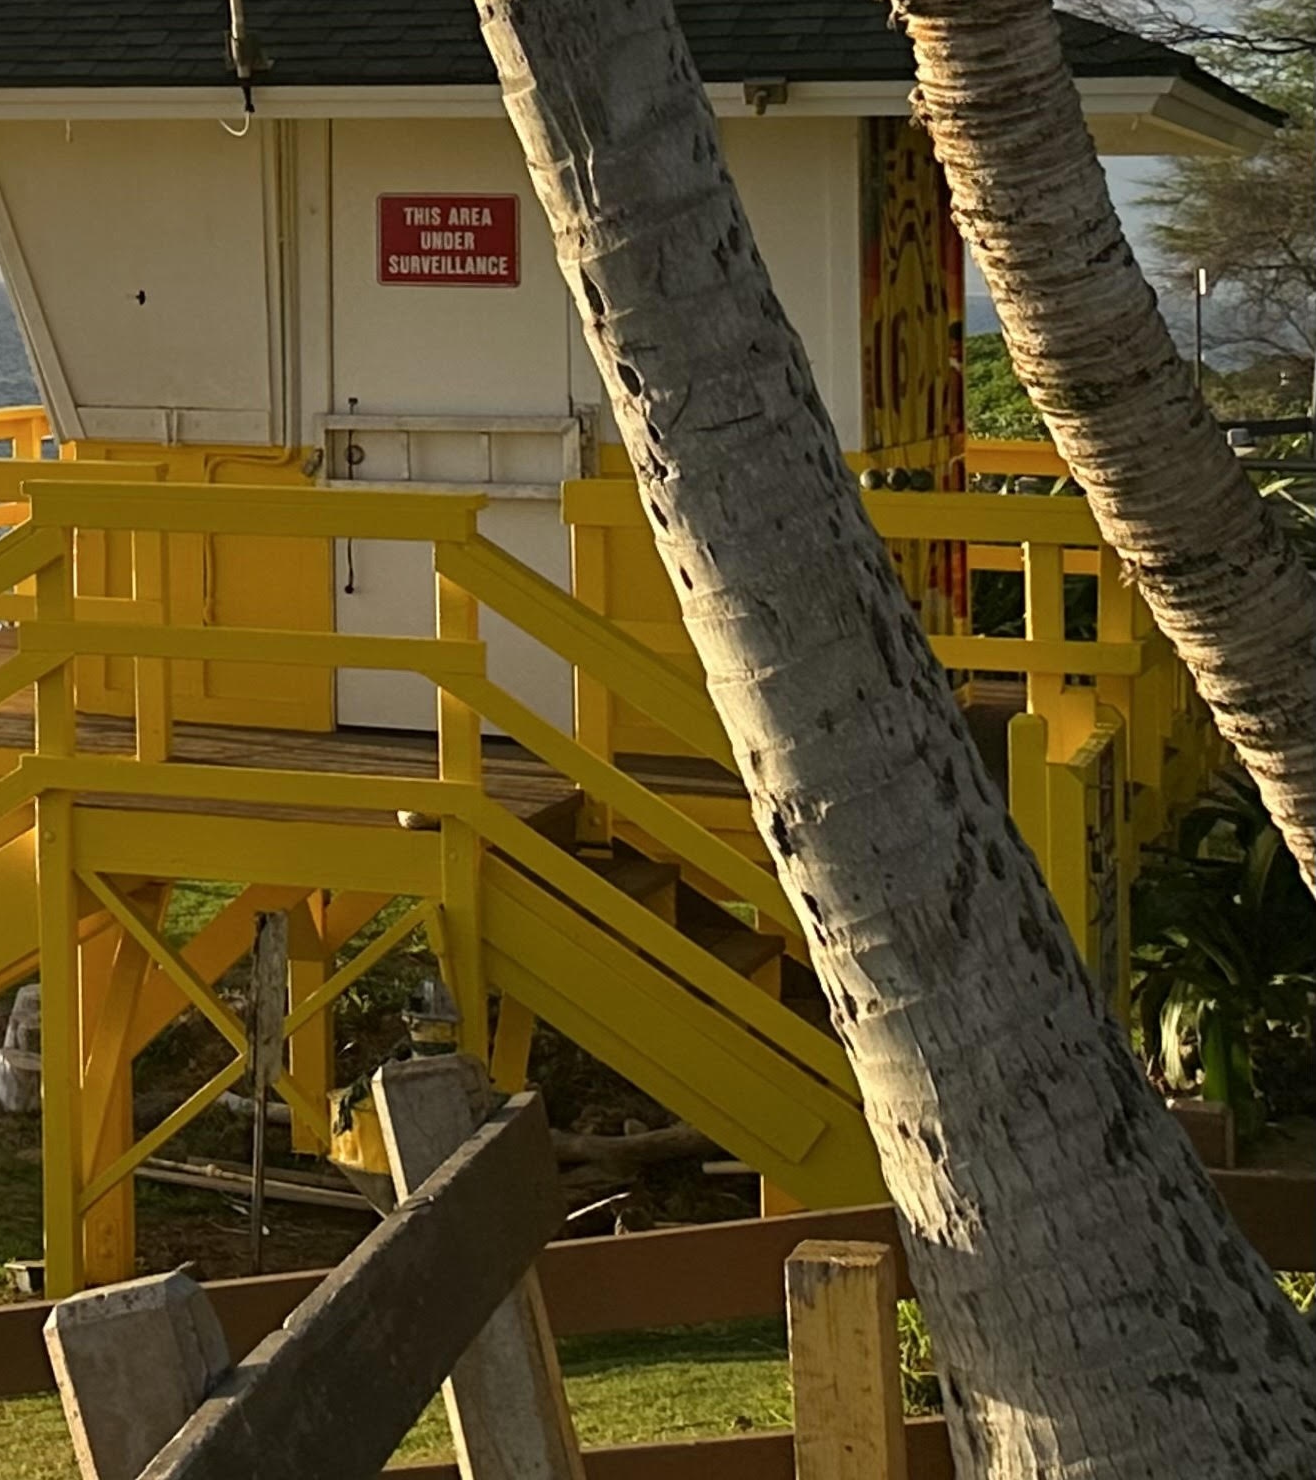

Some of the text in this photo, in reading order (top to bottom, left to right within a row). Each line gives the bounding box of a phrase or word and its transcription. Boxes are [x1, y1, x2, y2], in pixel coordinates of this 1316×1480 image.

[403, 207, 492, 226] THIS AREA
[420, 231, 475, 250] UNDER
[388, 255, 508, 275] SURVEILLANCE
